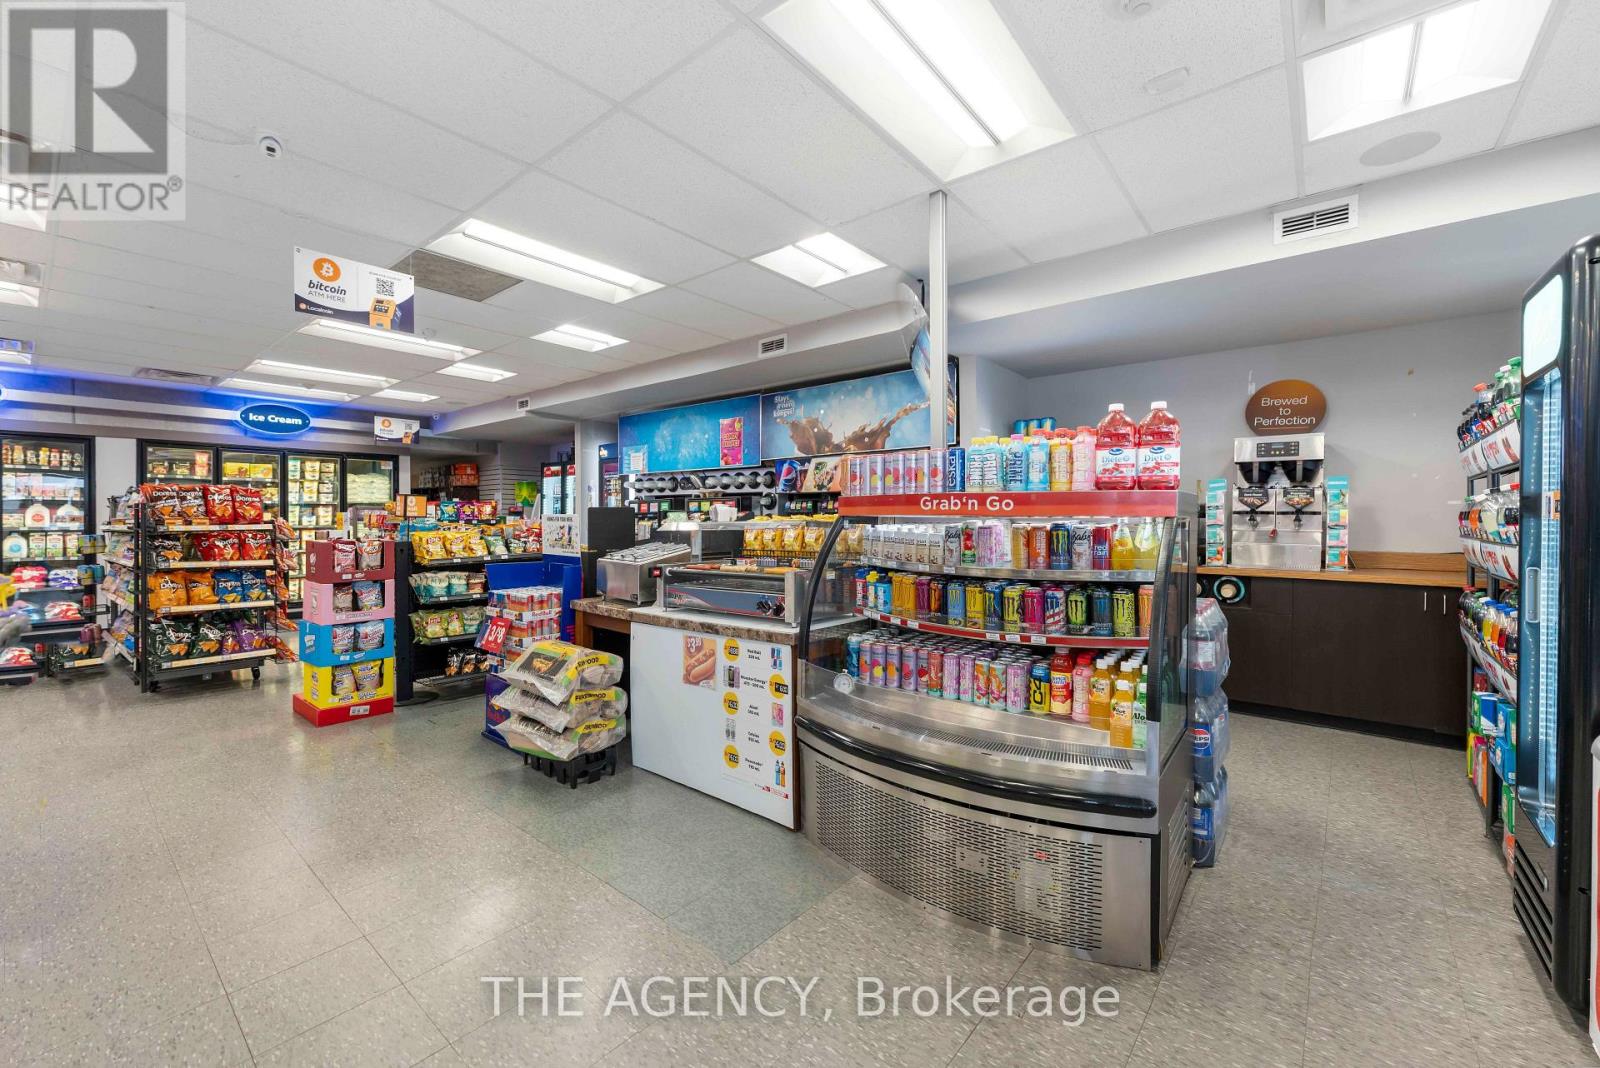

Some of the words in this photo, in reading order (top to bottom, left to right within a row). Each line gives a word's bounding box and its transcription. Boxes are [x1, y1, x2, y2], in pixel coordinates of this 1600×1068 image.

[307, 279, 347, 296] bitcoin
[307, 289, 324, 299] ATM
[326, 294, 346, 303] HERE
[1261, 396, 1308, 407] Brewed
[1279, 407, 1291, 416] to
[248, 412, 265, 422] Ice
[267, 414, 302, 425] Cream
[1253, 416, 1316, 426] Perfection
[947, 451, 957, 487] eska
[920, 496, 979, 511] Grab'n
[986, 496, 1014, 511] Go
